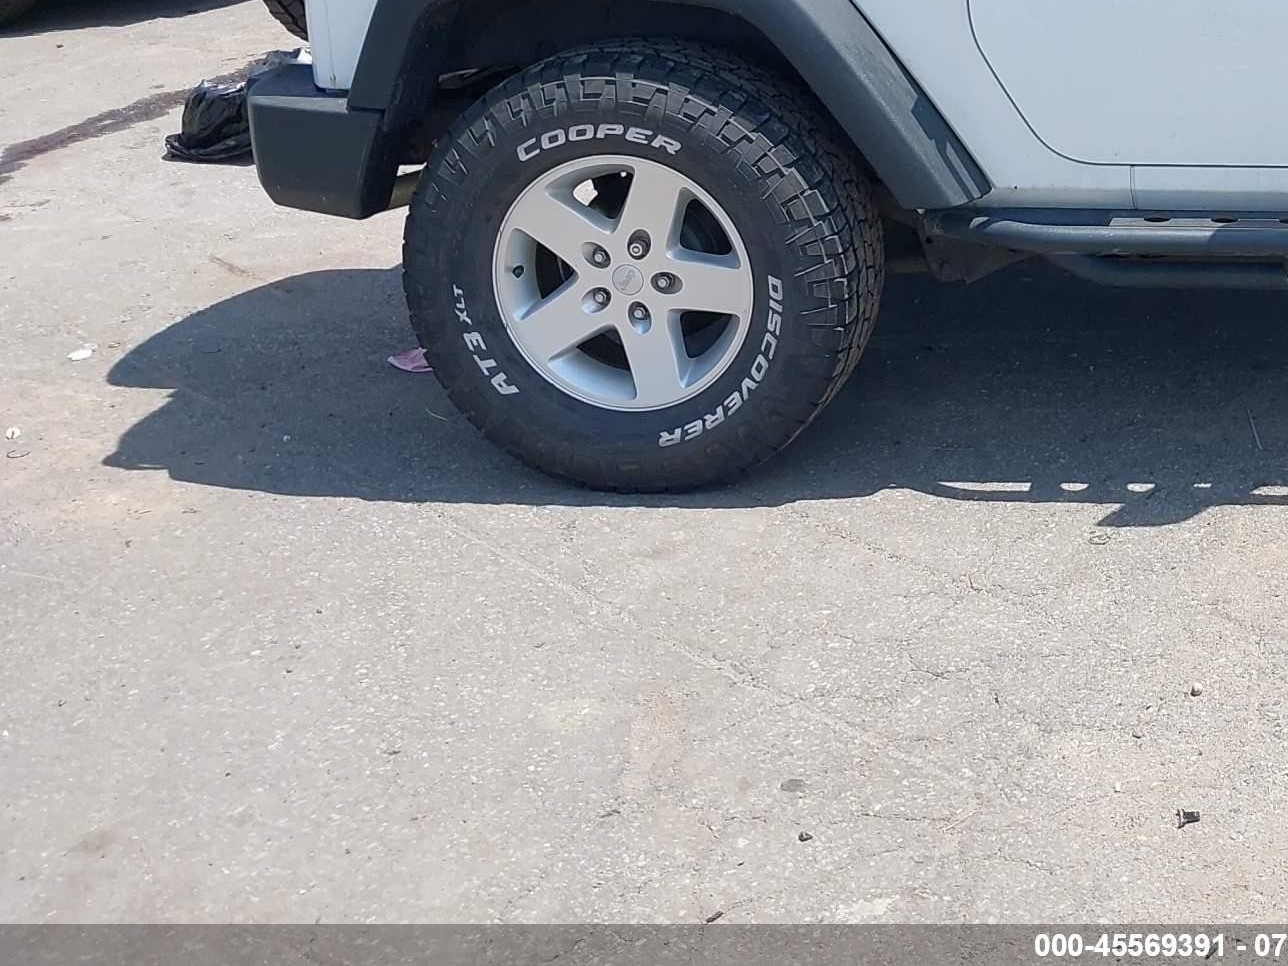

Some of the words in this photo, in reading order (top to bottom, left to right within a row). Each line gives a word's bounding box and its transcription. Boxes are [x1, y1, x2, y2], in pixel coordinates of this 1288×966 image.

[517, 124, 682, 162] COOPER
[463, 331, 520, 395] AT3
[658, 274, 784, 448] DISCOVERER
